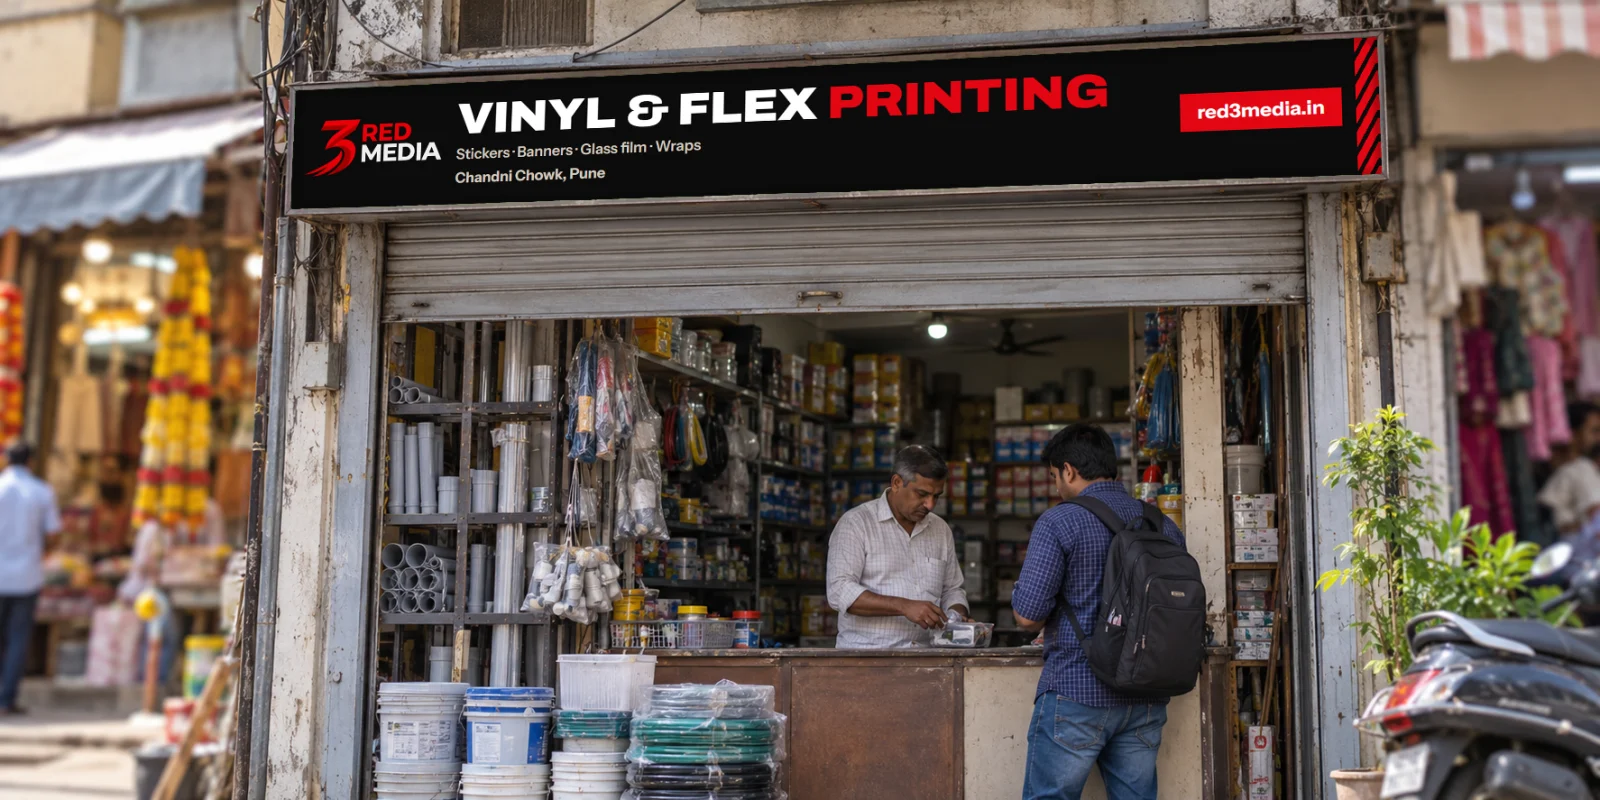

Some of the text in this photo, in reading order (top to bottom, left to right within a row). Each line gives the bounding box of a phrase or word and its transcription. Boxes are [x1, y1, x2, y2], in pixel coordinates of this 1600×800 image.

[459, 73, 1108, 134] VINYL & FLEX PRINTING
[1197, 98, 1324, 120] red3media.in
[362, 121, 412, 143] RED
[361, 142, 442, 163] MEDIA
[455, 139, 702, 160] Stickers Banners Glass film Wraps
[454, 167, 606, 184] Chandni Chowk, Pune
